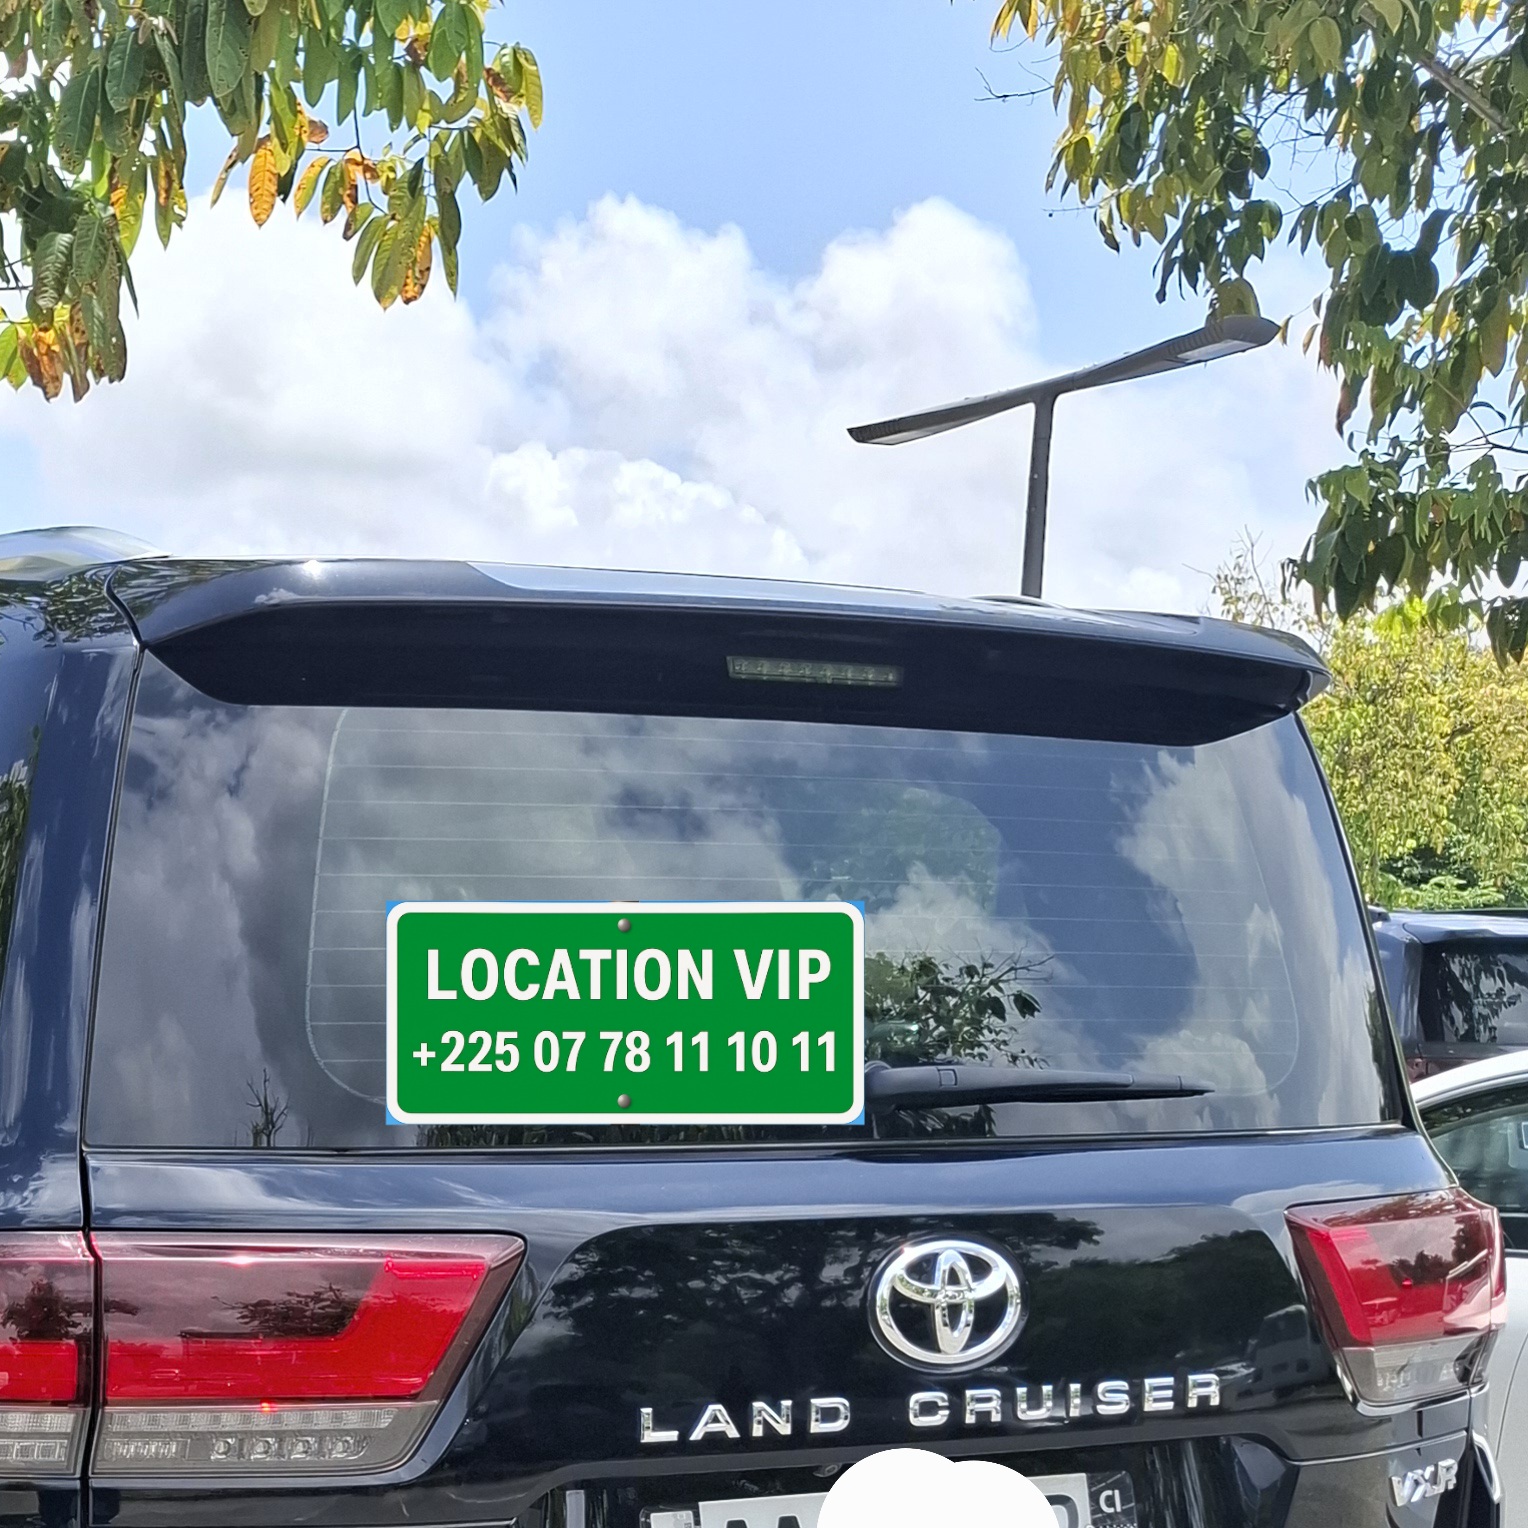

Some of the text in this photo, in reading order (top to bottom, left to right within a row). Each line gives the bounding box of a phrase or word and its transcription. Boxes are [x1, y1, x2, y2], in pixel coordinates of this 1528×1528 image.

[639, 1373, 1221, 1443] LAND CRUISER
[1099, 1489, 1122, 1514] CI
